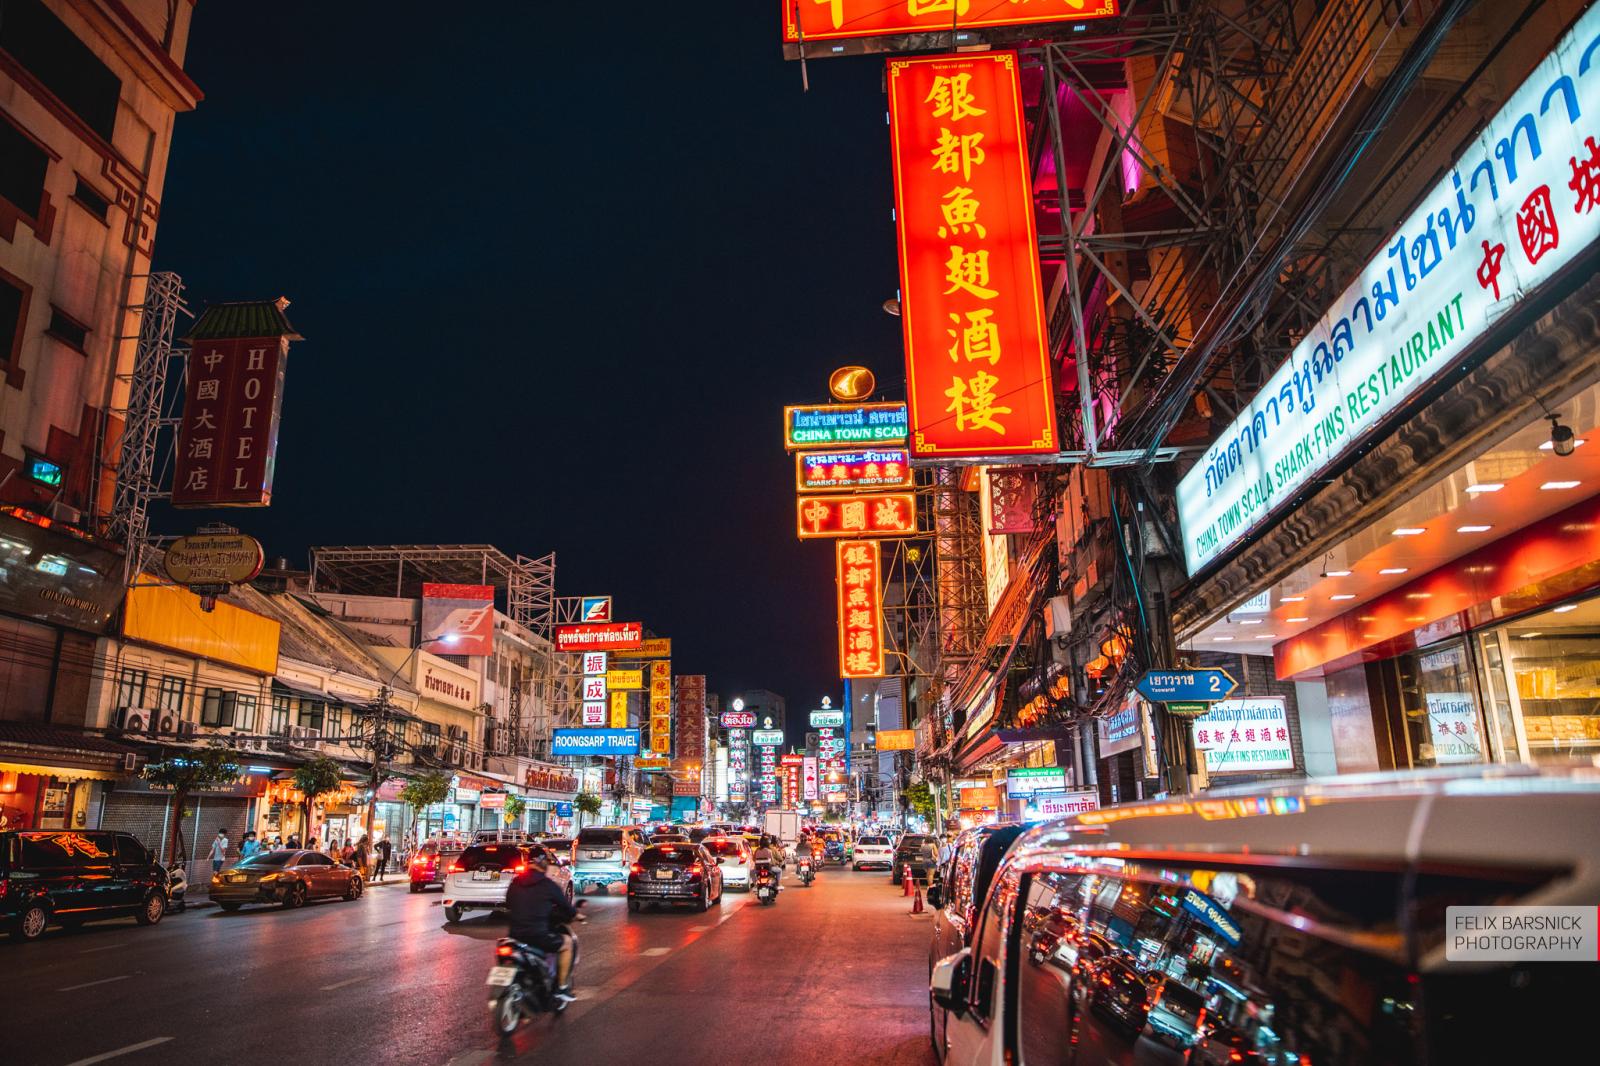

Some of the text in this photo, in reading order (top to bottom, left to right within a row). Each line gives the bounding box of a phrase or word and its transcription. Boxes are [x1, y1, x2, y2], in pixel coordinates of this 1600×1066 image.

[923, 72, 1012, 435] 銀都魚翅酒樓
[184, 348, 224, 491] 中國大酒店
[232, 348, 266, 491] HOTEL
[868, 406, 906, 424] สกาล่
[1196, 292, 1467, 558] CHINA TOWN SCALA SHARK-FINS RESTAURANT
[793, 426, 907, 441] CHINA TOWN SCAL
[804, 498, 905, 532] 中國城
[843, 546, 878, 672] 銀都魚翅酒樓
[586, 655, 603, 723] 振成豐
[1149, 674, 1221, 692] เยาวราช 2
[555, 734, 637, 748] ROONGSARP TRAVEL
[1197, 727, 1288, 744] 銀都魚翅酒樓
[1251, 748, 1291, 762] RESTAURANT
